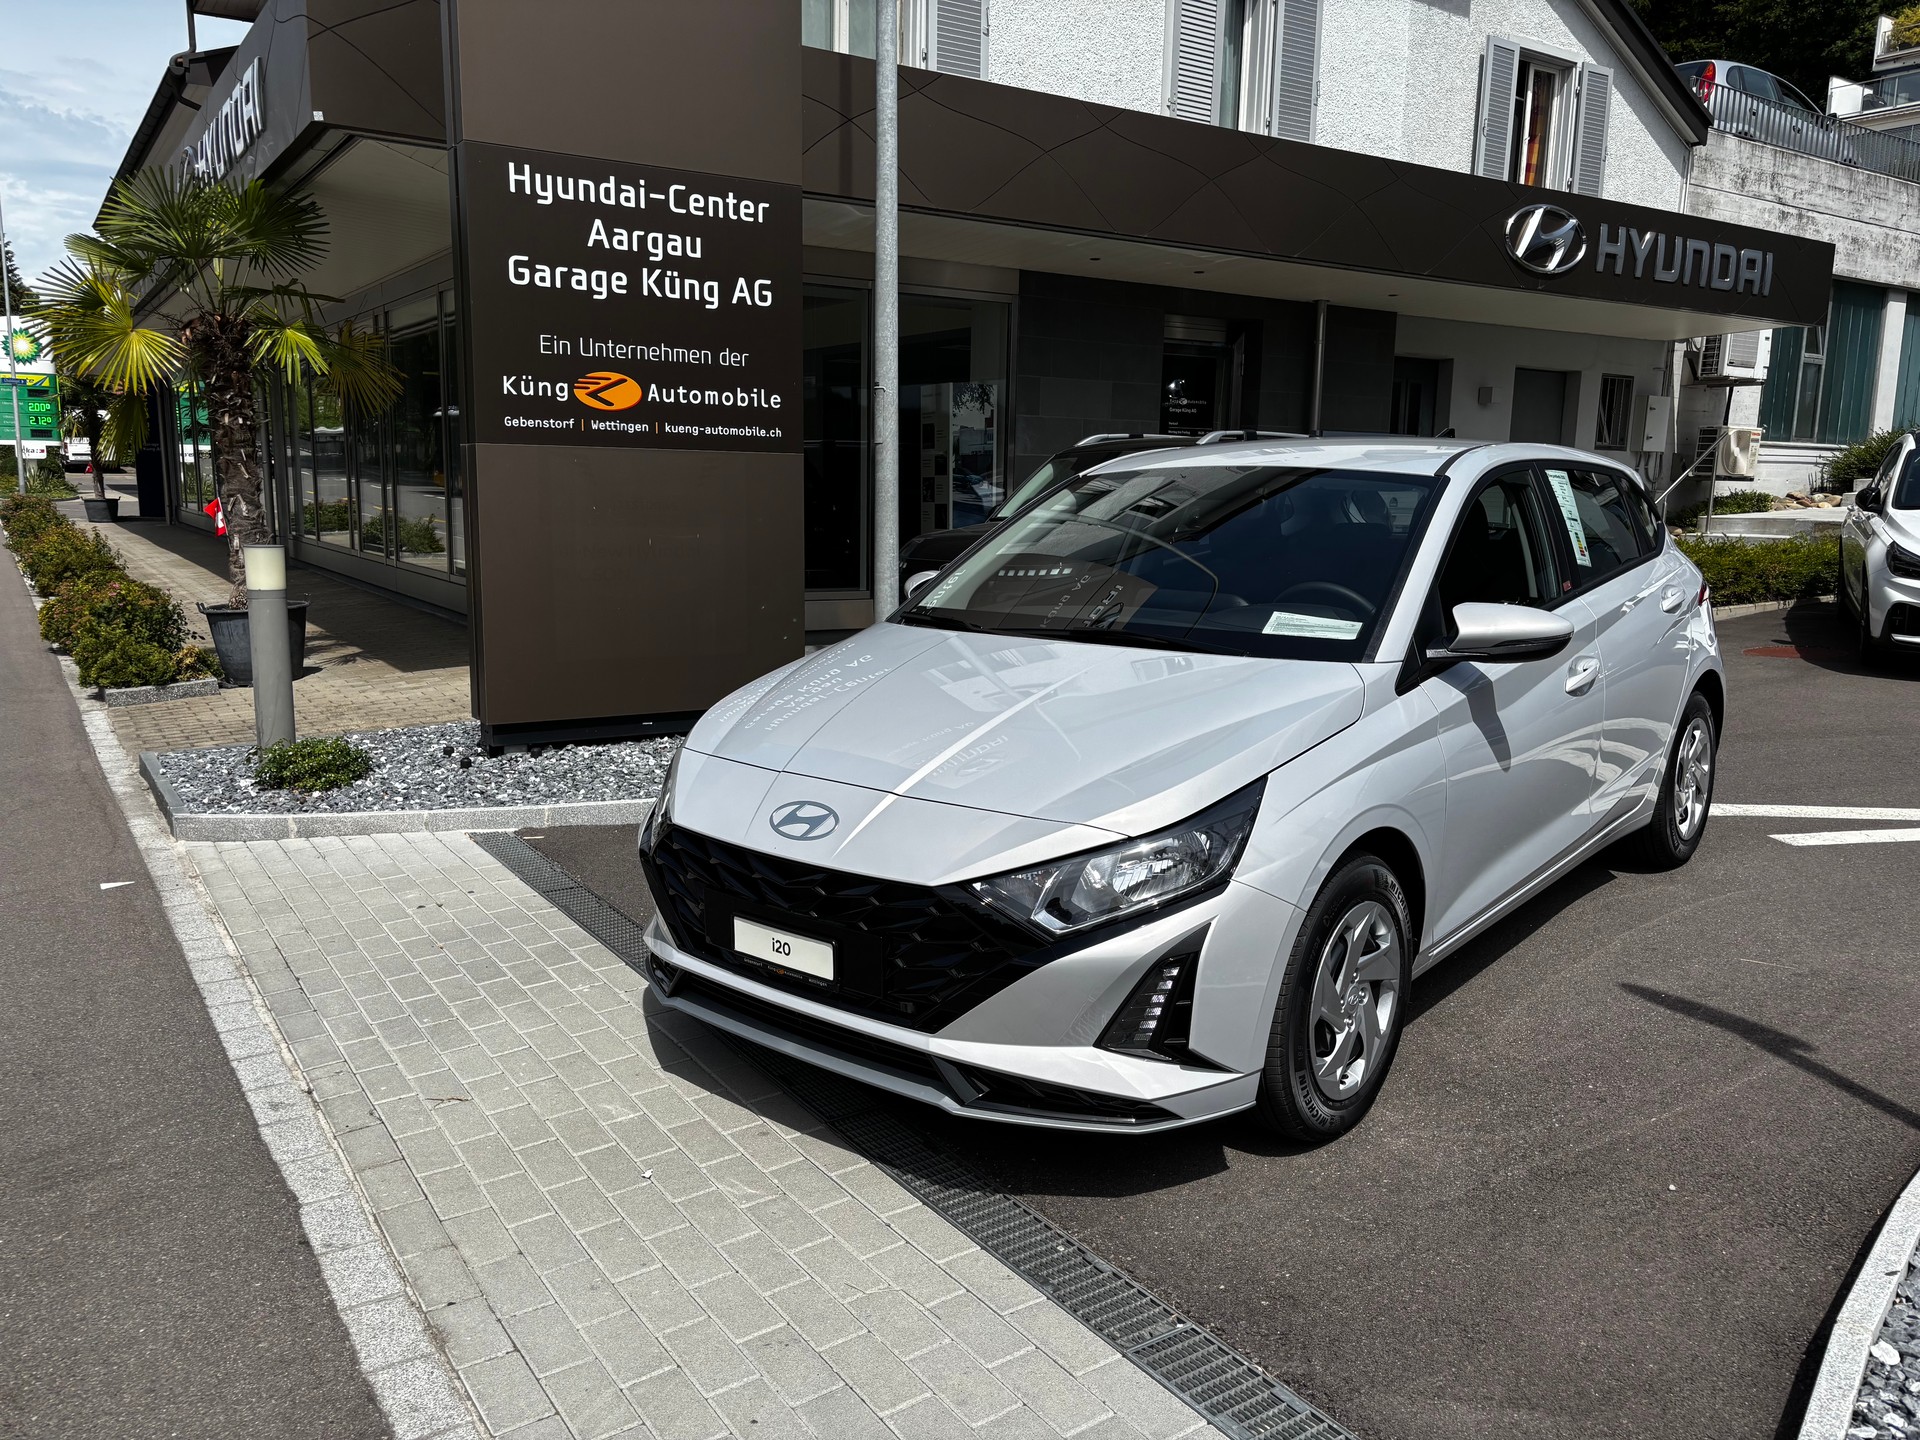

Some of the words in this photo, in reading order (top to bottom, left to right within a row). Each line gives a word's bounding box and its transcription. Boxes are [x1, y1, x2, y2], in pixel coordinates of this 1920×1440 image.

[508, 162, 770, 223] Hyundai-Center
[587, 218, 702, 262] Aargau
[1596, 223, 1774, 297] HYUNDAI
[508, 254, 628, 300] Garage
[642, 267, 719, 310] Küng
[732, 277, 773, 307] AG
[539, 334, 571, 356] Ein
[580, 337, 712, 365] Unternehmen
[719, 347, 750, 367] der
[502, 375, 569, 402] Küng
[647, 384, 782, 409] Automobile
[504, 416, 575, 430] Gebenstorf
[590, 419, 649, 433] Wettingen
[664, 422, 782, 438] kueng-automobile.ch
[771, 937, 791, 957] i20
[1298, 1073, 1330, 1128] MICHELIN
